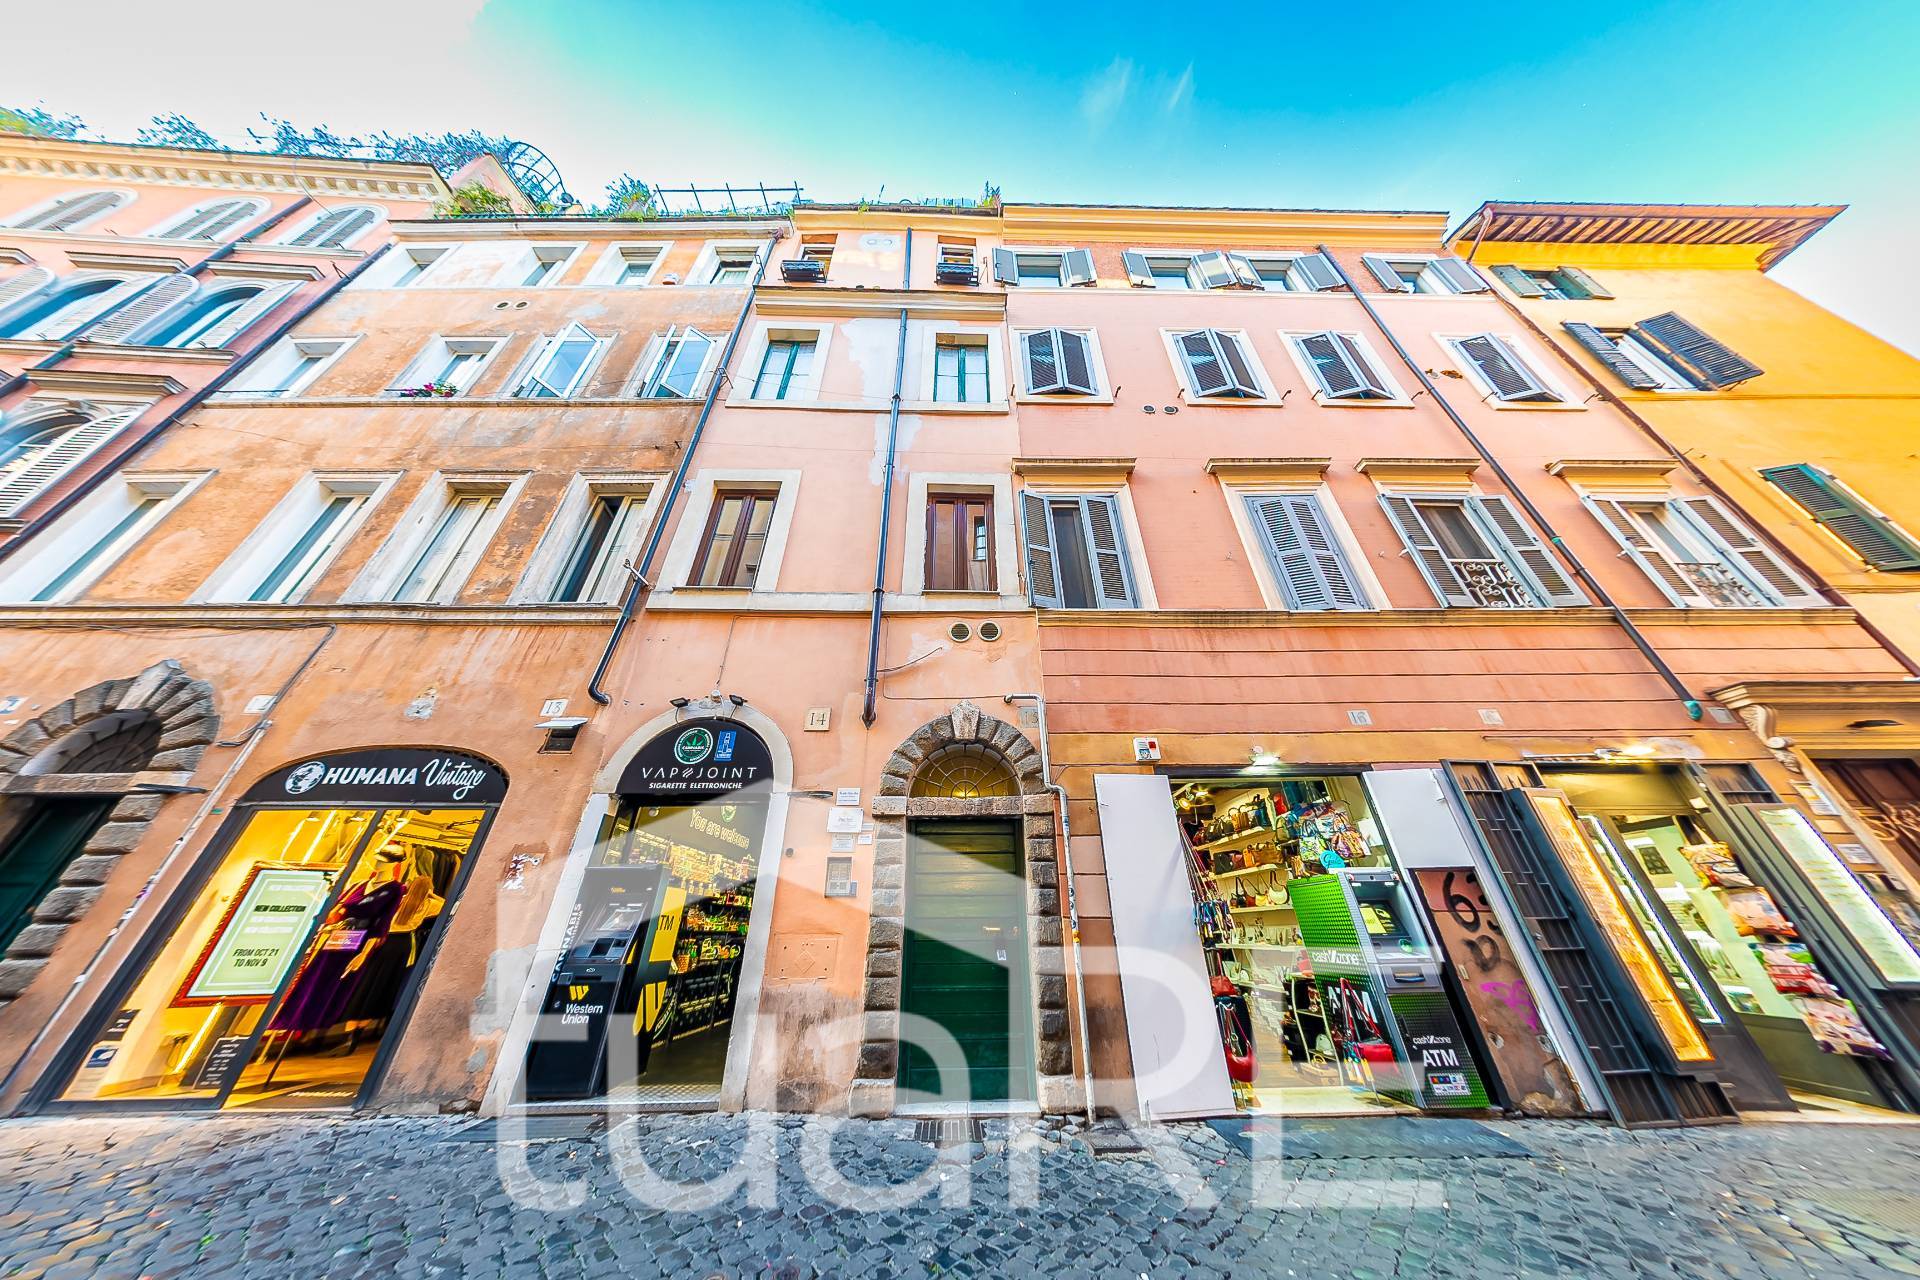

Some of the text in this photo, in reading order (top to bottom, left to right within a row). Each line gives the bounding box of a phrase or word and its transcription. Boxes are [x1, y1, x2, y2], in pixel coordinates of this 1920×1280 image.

[546, 701, 563, 714] 13
[810, 712, 827, 725] 14
[322, 758, 487, 800] HUMANA Vintage
[689, 808, 708, 832] You
[706, 821, 721, 838] are
[656, 914, 675, 931] TM
[551, 903, 582, 982] CANNABIS
[233, 949, 280, 957] FROM OCT 21
[234, 959, 246, 967] TO
[246, 959, 261, 967] NOV
[565, 1003, 604, 1014] Western
[561, 1013, 590, 1025] Union
[1422, 1048, 1460, 1067] ATM
